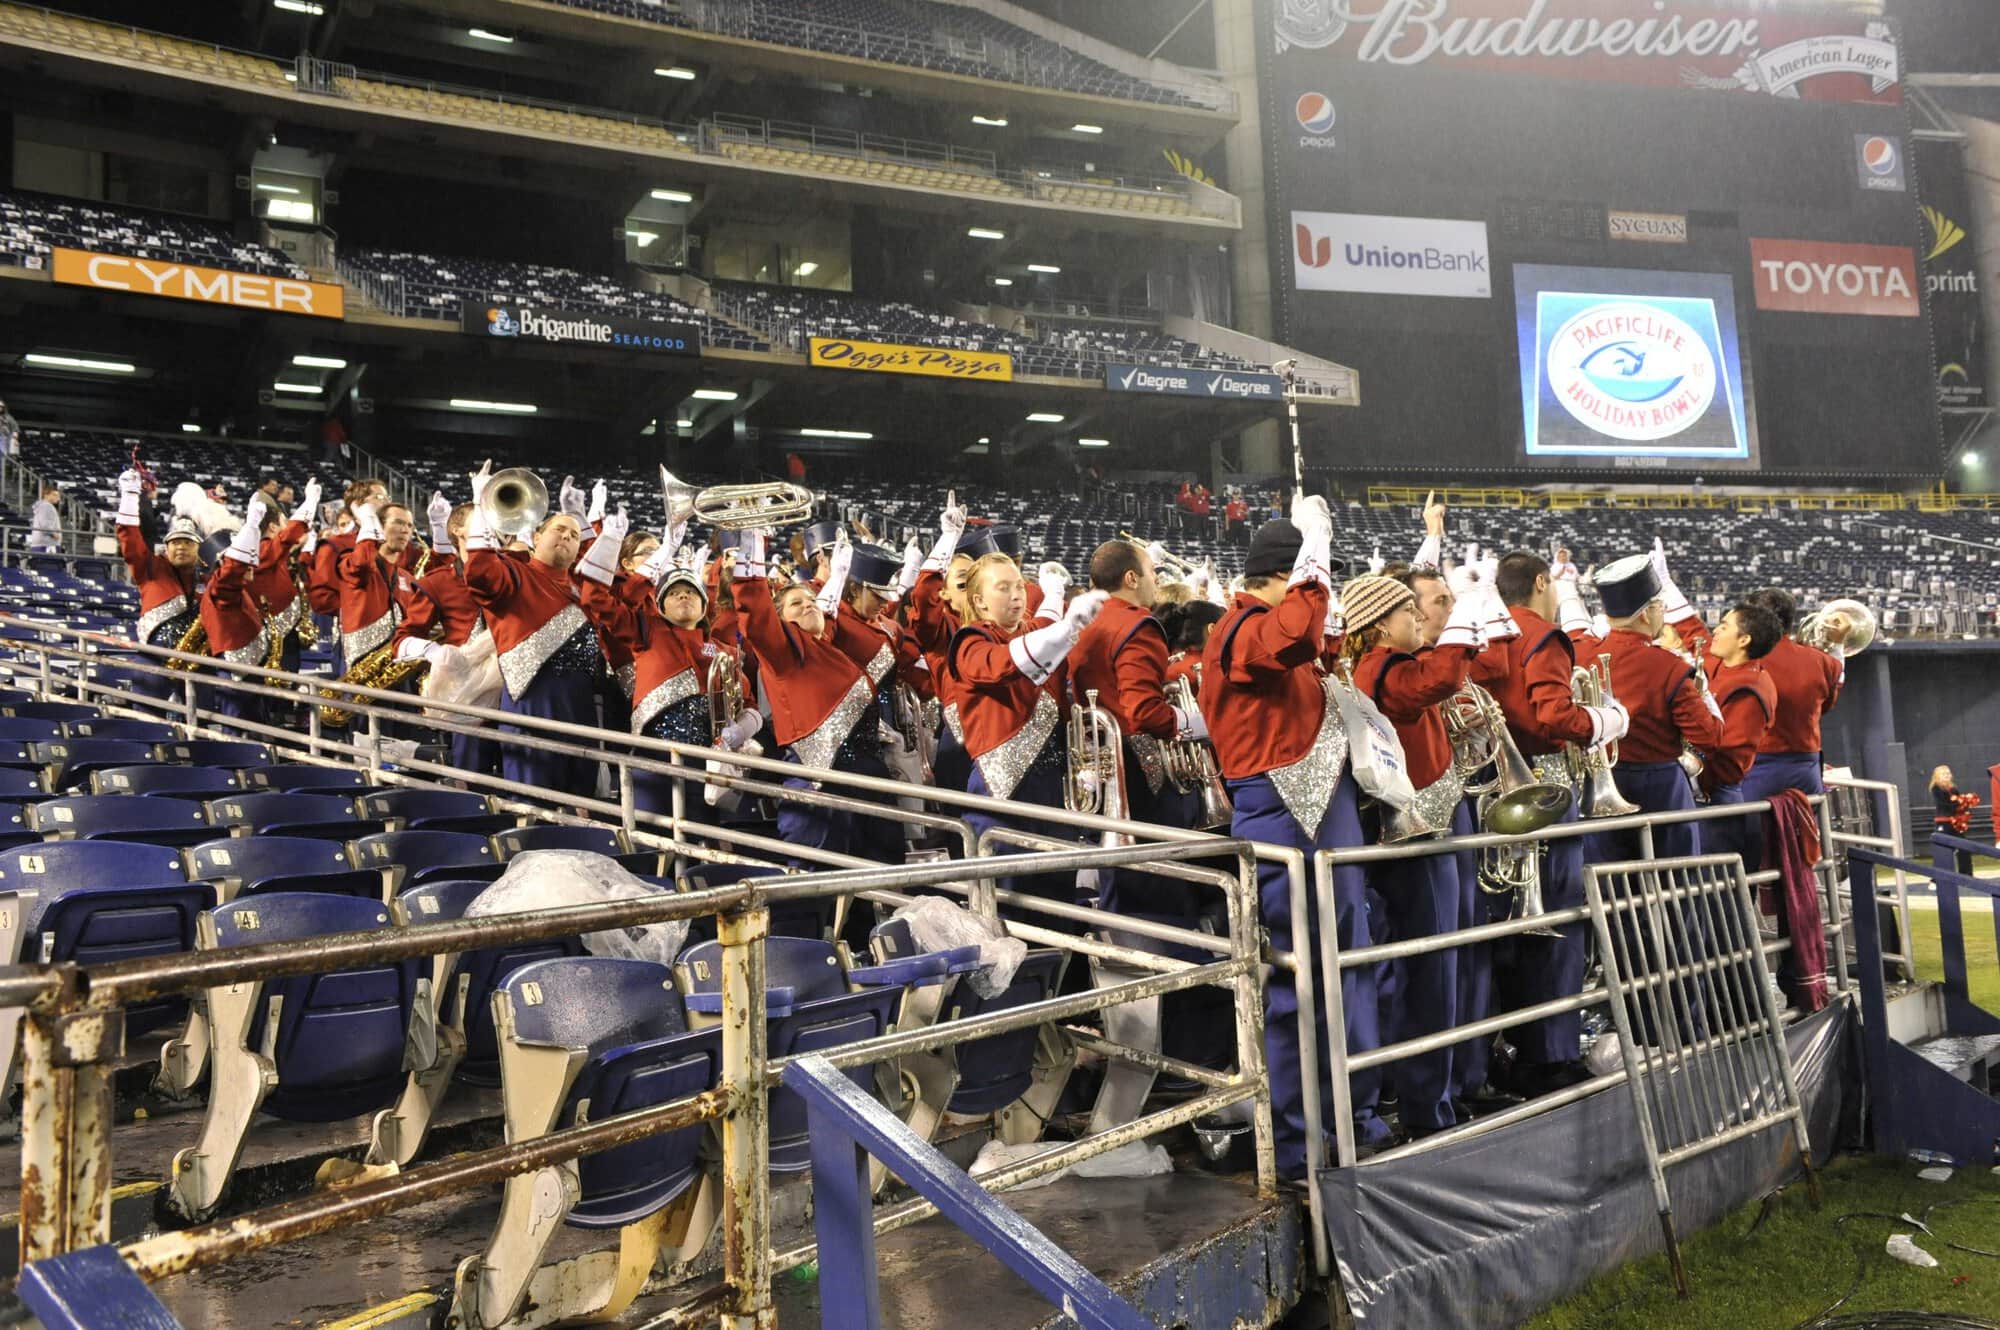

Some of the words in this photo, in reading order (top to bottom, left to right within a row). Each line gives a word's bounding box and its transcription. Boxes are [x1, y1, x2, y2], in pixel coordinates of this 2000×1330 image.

[1340, 0, 1758, 65] Budweiser
[1769, 50, 1842, 83] American
[1847, 47, 1893, 71] Lager
[1300, 136, 1336, 148] pepsi
[1609, 216, 1686, 236] SYCUAN
[1345, 243, 1486, 273] UnionBank
[88, 256, 315, 313] CYMER
[1760, 260, 1911, 298] TOYOTA
[1925, 270, 1978, 298] print
[519, 309, 613, 343] Brigantine
[614, 333, 685, 350] SEAFOOD
[1572, 316, 1644, 349] PACIFIC
[1646, 316, 1686, 352] LIFE
[817, 341, 912, 369] Oggi's
[914, 350, 1004, 375] Pizza
[1136, 372, 1189, 391] Degree
[1221, 378, 1272, 396] Degree
[1567, 381, 1647, 428] HOLIDAY
[1652, 389, 1701, 427] BOWL
[28, 857, 37, 873] 4
[2, 911, 8, 929] 3
[242, 912, 251, 928] 4
[527, 984, 538, 1003] 3
